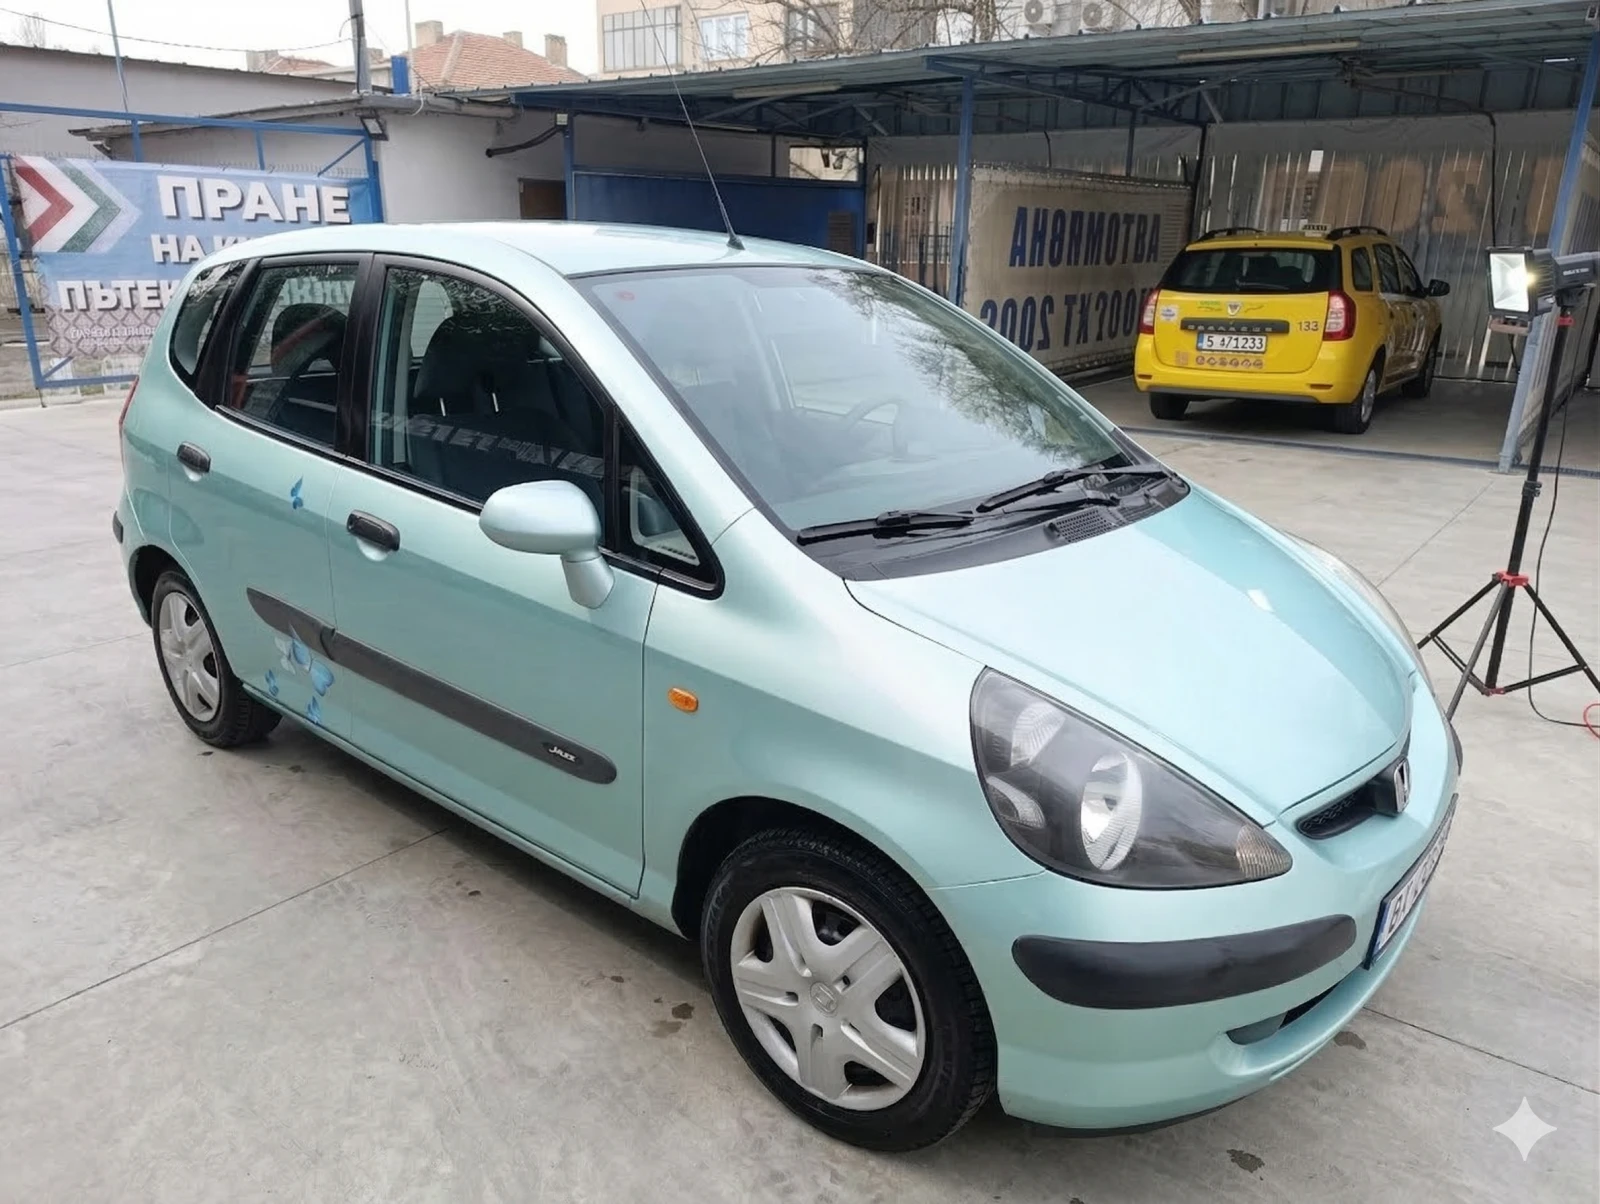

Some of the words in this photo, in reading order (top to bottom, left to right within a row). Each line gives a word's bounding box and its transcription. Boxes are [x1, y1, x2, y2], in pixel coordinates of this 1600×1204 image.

[156, 175, 351, 224] ПРАНЕ
[151, 234, 207, 263] НА
[1298, 321, 1319, 332] 133
